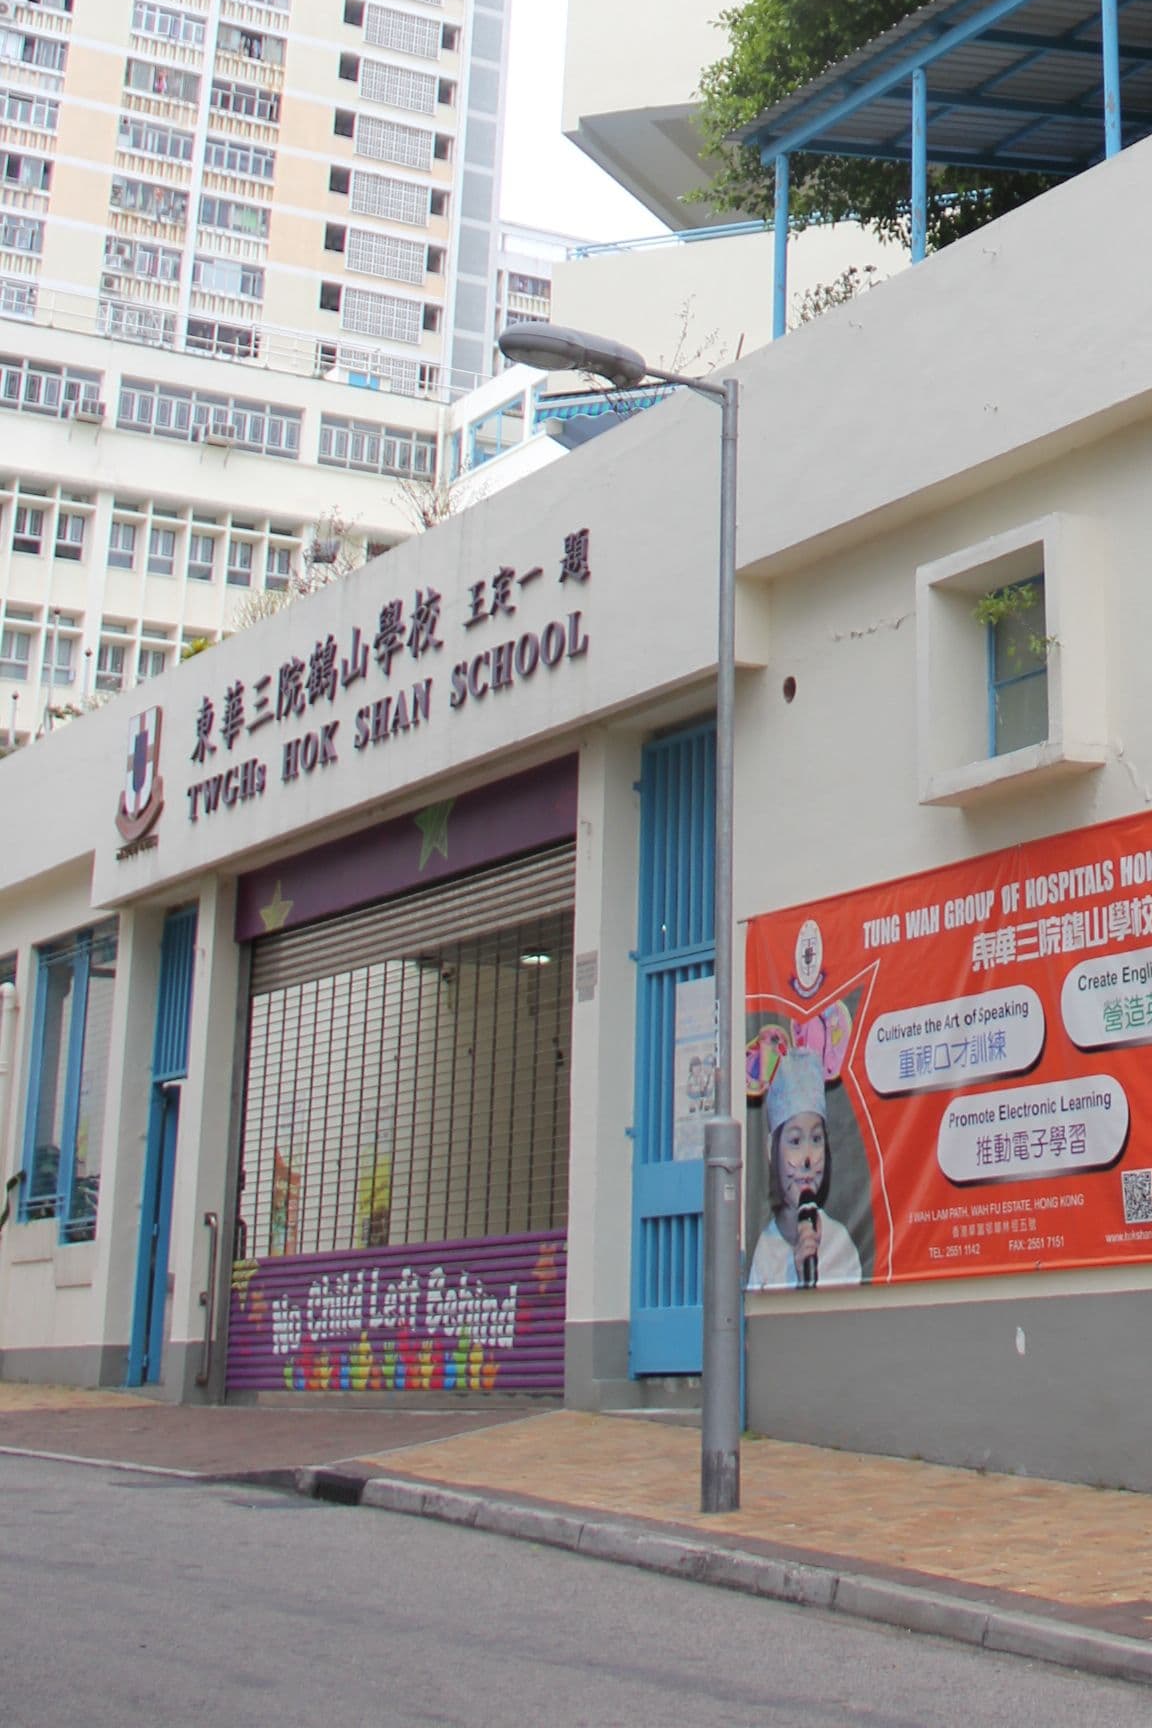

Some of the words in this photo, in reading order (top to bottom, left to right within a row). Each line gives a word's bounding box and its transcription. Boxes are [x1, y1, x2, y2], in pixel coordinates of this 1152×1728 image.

[190, 586, 445, 763] 東華三院鶴山學校
[187, 757, 267, 822] TWGHs
[282, 719, 340, 784] HOK
[353, 677, 433, 750] SHAN
[450, 610, 590, 709] SCHOOL
[863, 914, 901, 949] TUNG
[905, 904, 940, 941] WAH
[944, 889, 995, 930] GROUP
[1001, 882, 1021, 915] OF
[1025, 860, 1114, 909] HOSPITALS
[1077, 971, 1118, 992] Create
[877, 1023, 923, 1043] Cultivate
[925, 1018, 943, 1035] the
[944, 1014, 961, 1030] Art
[964, 1008, 977, 1026] of
[978, 1000, 1029, 1025] Speaking
[898, 1029, 1007, 1080] 重視口才訓練
[949, 1109, 996, 1129] Promote
[999, 1098, 1057, 1121] Electronic
[1060, 1090, 1112, 1112] Learning
[976, 1123, 1087, 1167] 推動電子學習
[931, 1208, 949, 1221] LAM
[971, 1204, 990, 1217] WAH
[990, 1202, 1001, 1215] FU
[1034, 1196, 1059, 1210] HONG
[1059, 1193, 1085, 1207] KONG
[946, 1244, 963, 1257] 2551
[1027, 1237, 1045, 1250] 2551
[272, 1293, 301, 1355] No
[307, 1268, 364, 1342] Child
[369, 1266, 421, 1333] Left
[425, 1265, 518, 1349] Behind
